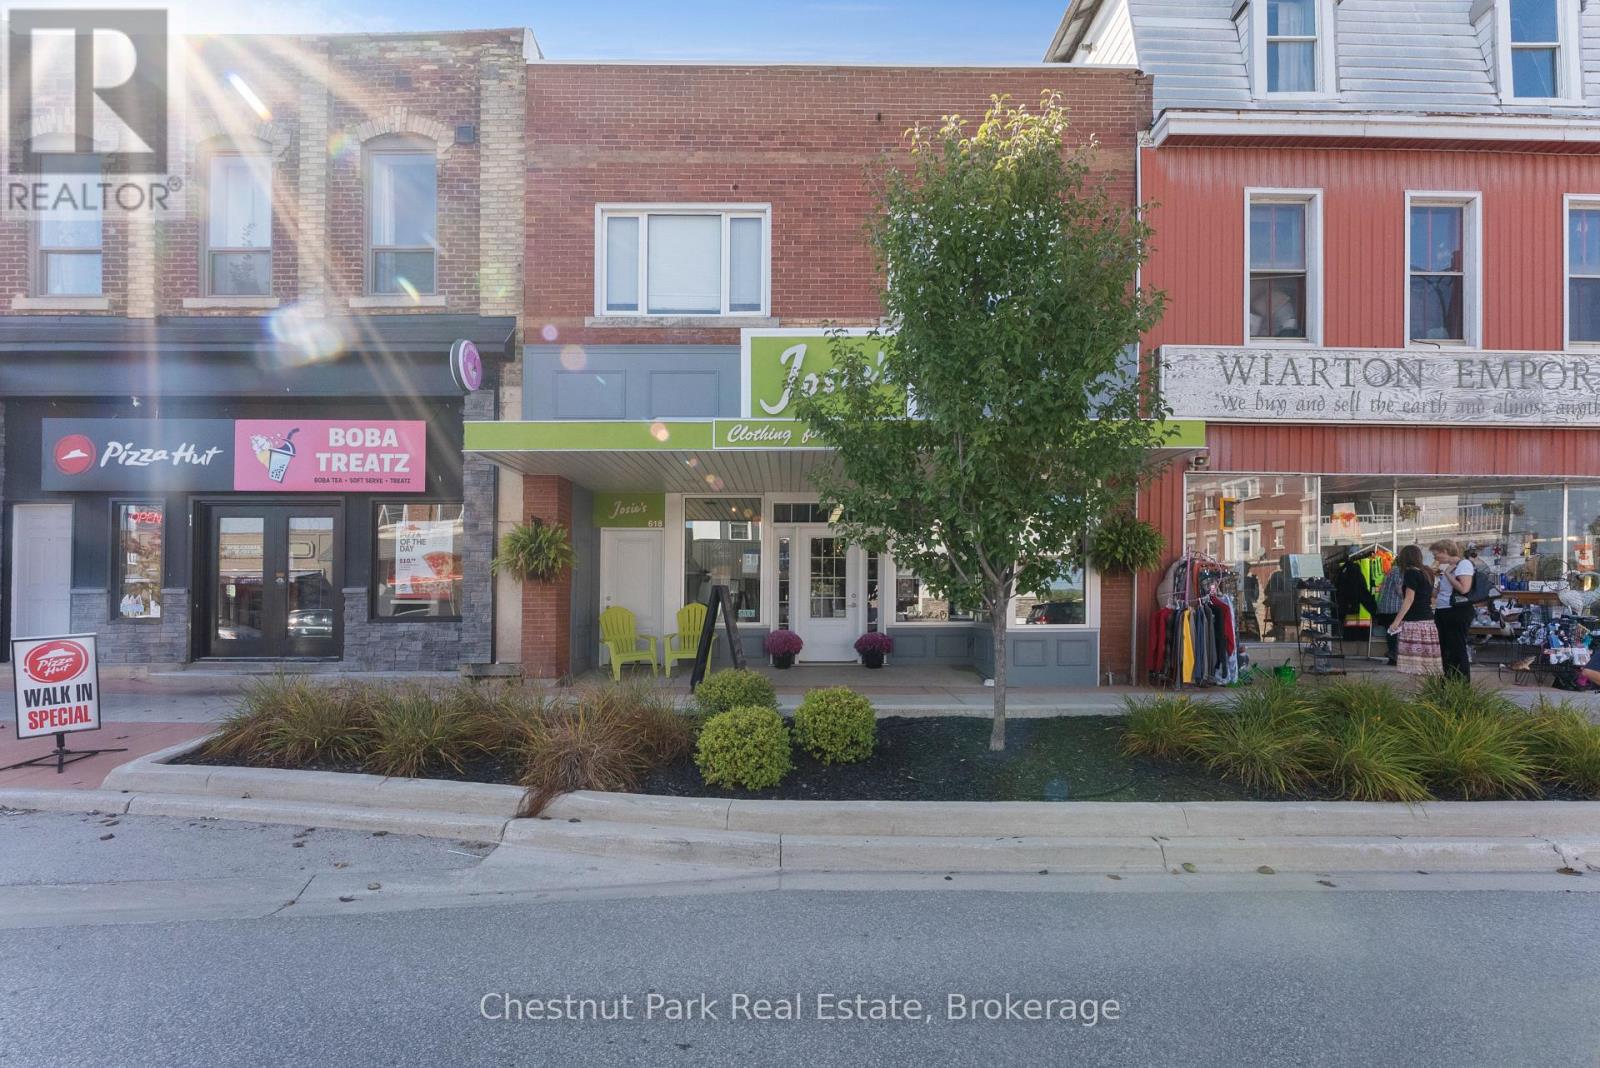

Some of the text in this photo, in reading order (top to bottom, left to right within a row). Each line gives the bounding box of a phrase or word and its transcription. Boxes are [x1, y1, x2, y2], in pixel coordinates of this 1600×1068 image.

[1217, 353, 1426, 389] WIARTON
[1219, 393, 1247, 412] We
[1255, 389, 1287, 416] buy
[1296, 395, 1326, 412] and
[1334, 390, 1361, 412] sell
[1370, 391, 1394, 413] the
[1402, 392, 1447, 415] earth
[1456, 395, 1485, 415] and
[329, 428, 399, 448] BOBA
[727, 424, 792, 446] Clothing
[100, 441, 224, 468] Pizza Hut
[315, 452, 410, 473] TREATZ
[366, 477, 384, 485] SERVE
[133, 510, 162, 523] OPEN
[608, 501, 648, 519] Josie's
[648, 520, 663, 528] 618
[36, 657, 74, 673] Pizza
[44, 663, 72, 677] Hut
[24, 683, 93, 708] WALK IN
[28, 705, 92, 729] SPECIAL
